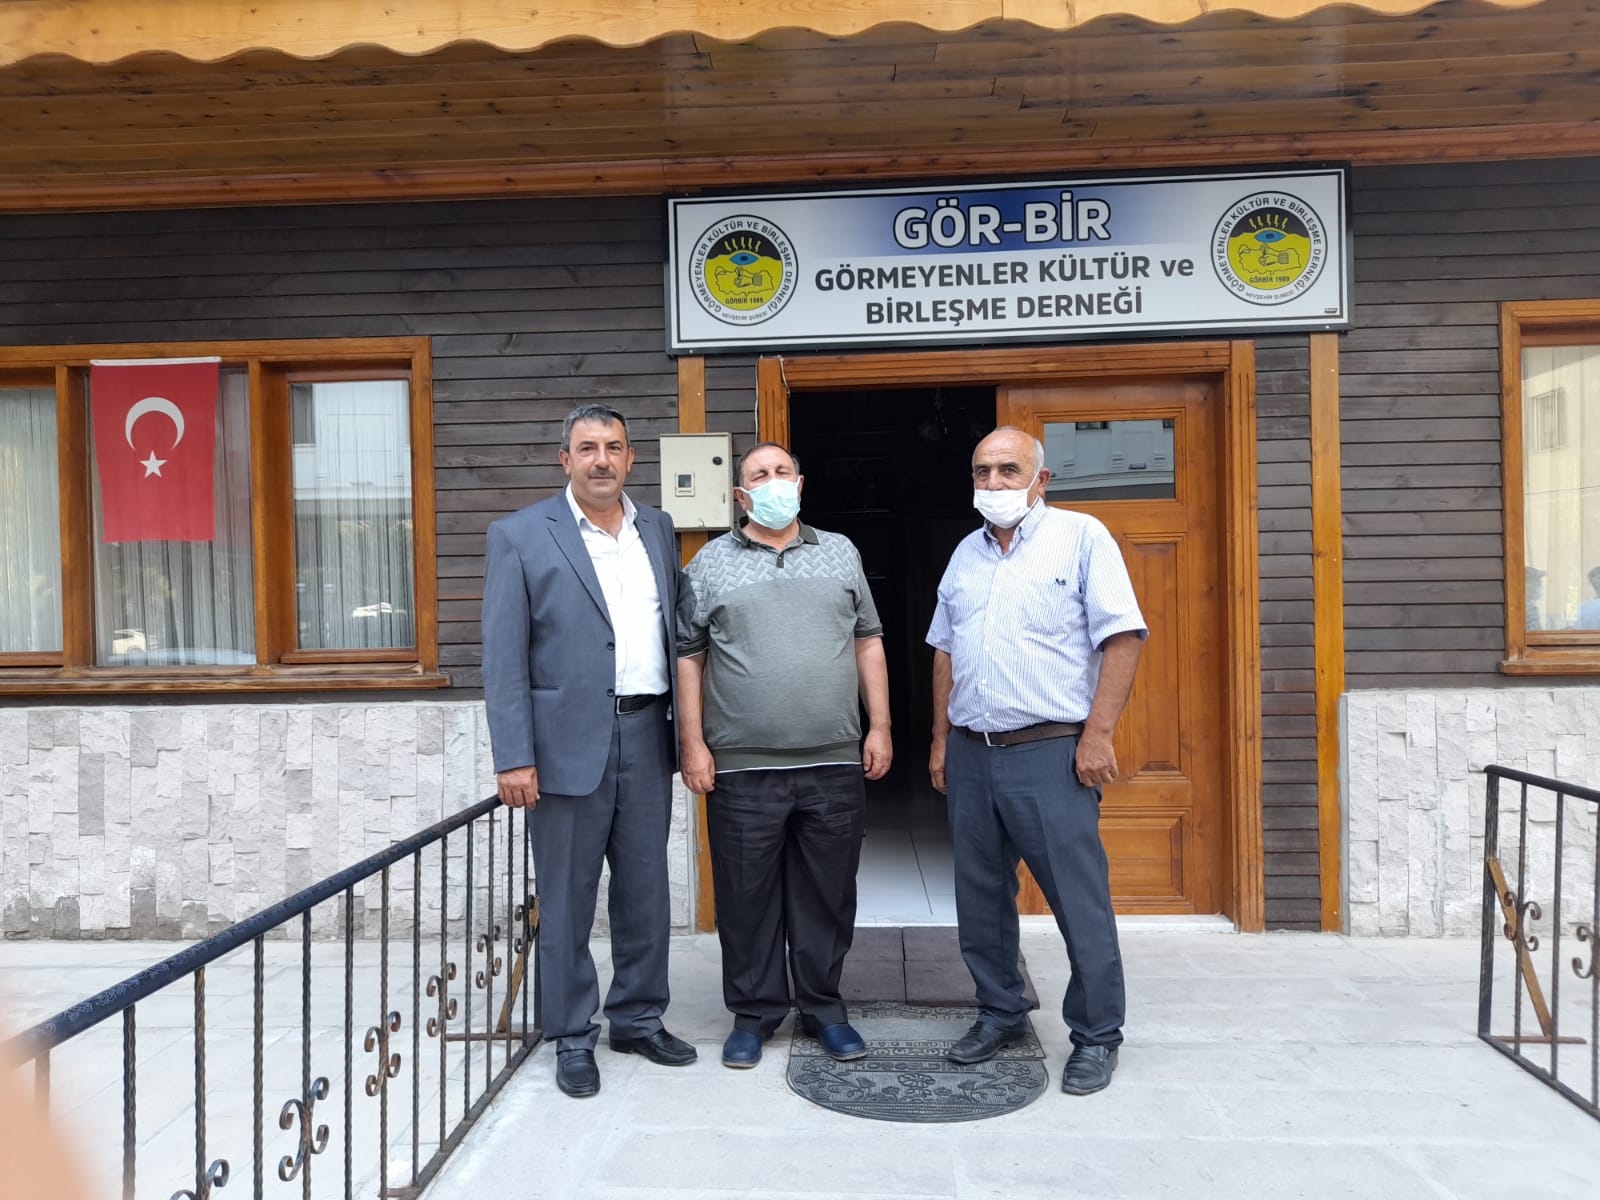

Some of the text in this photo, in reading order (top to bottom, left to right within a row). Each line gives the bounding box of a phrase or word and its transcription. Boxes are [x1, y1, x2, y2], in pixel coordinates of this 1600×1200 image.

[893, 191, 1112, 249] GÖR-BİR
[1230, 197, 1270, 221] KÜLTÜR
[1273, 197, 1287, 207] VE
[694, 243, 722, 313] GÖRMEYENLER
[708, 220, 744, 243] KÜLTÜR
[747, 221, 759, 230] VE
[769, 271, 793, 312] DERNEĞİ
[814, 251, 1194, 292] GÖRMEYENLER KÜLTÜR ve
[1217, 221, 1246, 292] GÖRMEYENLER
[1295, 248, 1321, 290] DERNEĞİ
[866, 286, 1143, 327] BİRLEŞME DERNEĞİ
